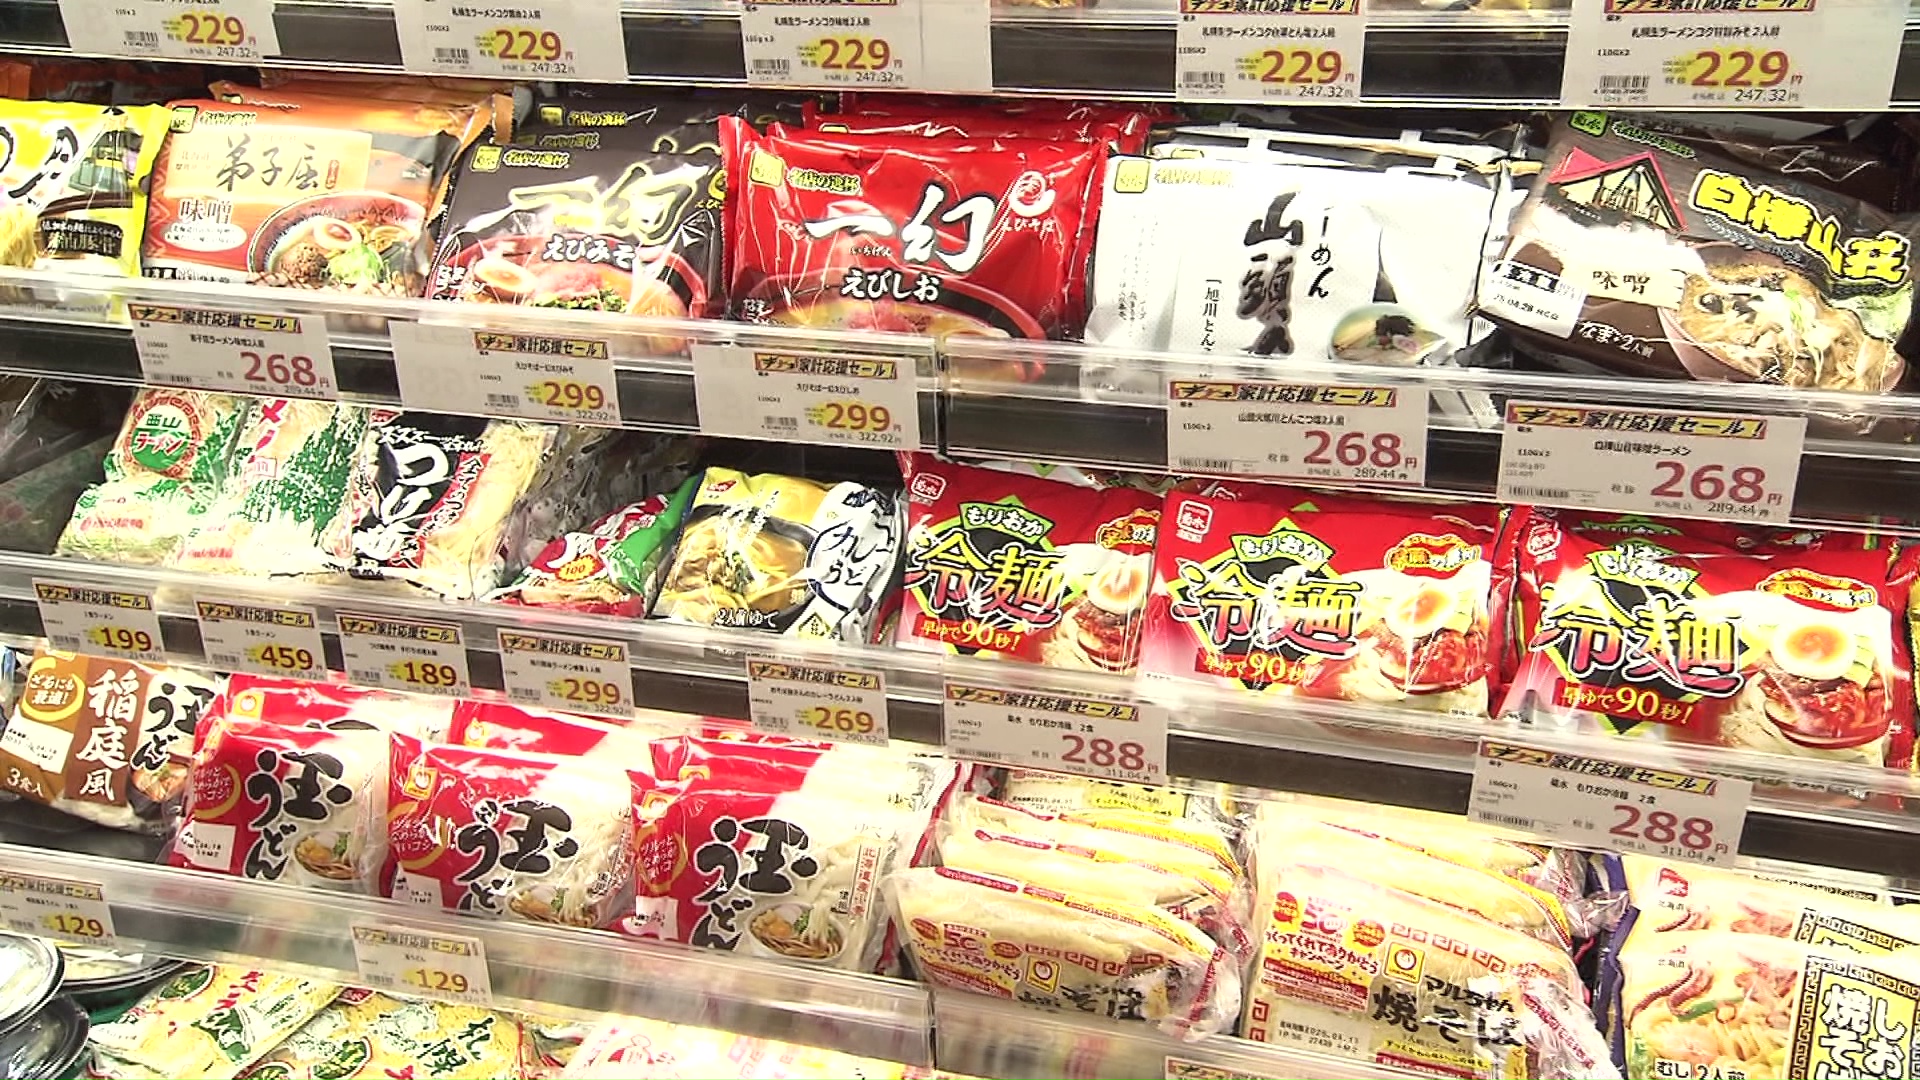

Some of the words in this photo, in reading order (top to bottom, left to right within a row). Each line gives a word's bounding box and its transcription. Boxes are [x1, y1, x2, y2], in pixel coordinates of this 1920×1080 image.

[181, 14, 245, 47] 229
[495, 30, 561, 62] 229
[819, 38, 891, 71] 229
[1260, 50, 1343, 84] 229
[1691, 50, 1790, 88] 229
[804, 183, 996, 273] 一幻
[543, 236, 636, 265] えびみそ
[841, 269, 941, 303] えびしお
[240, 351, 317, 387] 268
[544, 381, 604, 410] 299
[826, 402, 890, 432] 299
[1303, 430, 1402, 468] 268
[1650, 461, 1766, 504] 268
[966, 506, 1045, 539] もりおか
[904, 529, 1063, 629] 冷麺
[1171, 560, 1365, 659] 冷麺
[99, 626, 153, 652] 199
[260, 645, 314, 671] 459
[403, 661, 458, 687] 189
[564, 678, 621, 705] 299
[75, 668, 140, 802] 稲庭風
[814, 706, 874, 733] 269
[1061, 734, 1145, 771] 288
[7, 769, 44, 798] 3食入
[1609, 804, 1714, 851] 288
[55, 915, 104, 939] 129
[416, 968, 469, 993] 129
